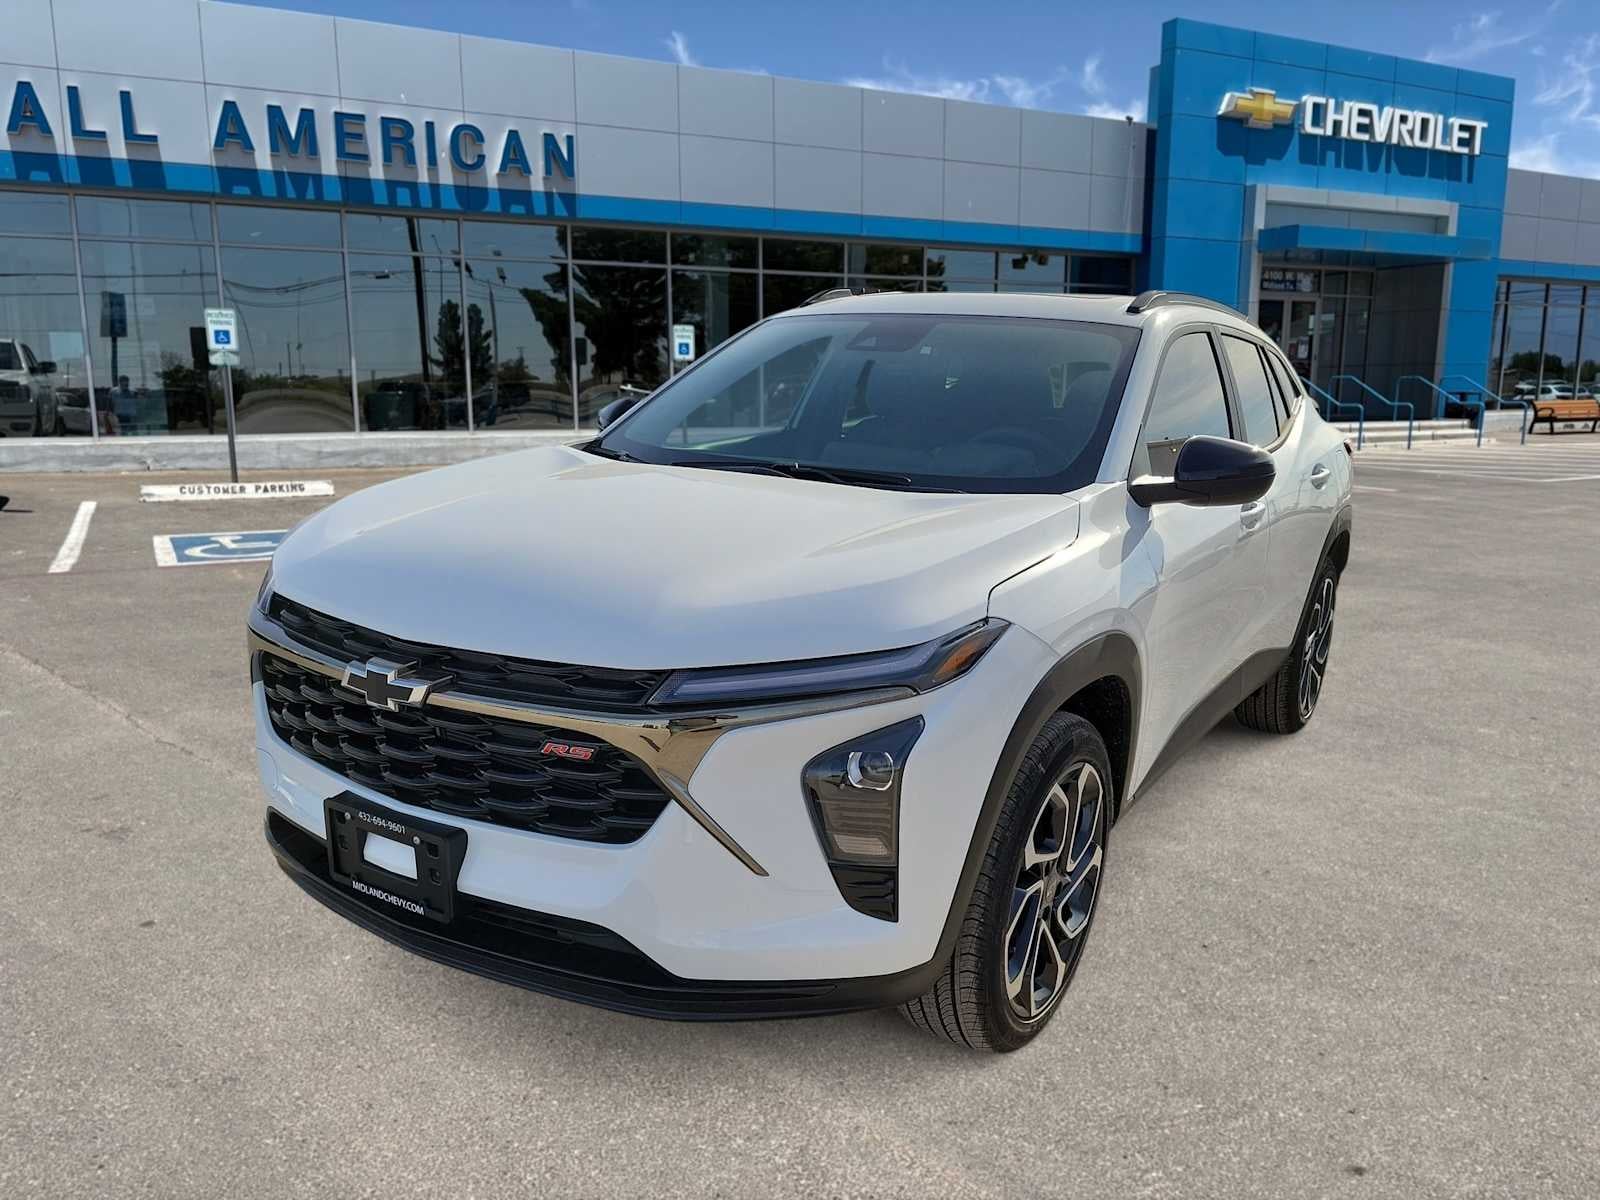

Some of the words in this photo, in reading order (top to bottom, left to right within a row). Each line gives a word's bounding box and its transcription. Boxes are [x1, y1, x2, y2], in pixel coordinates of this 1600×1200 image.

[7, 80, 158, 144] ALL
[213, 99, 576, 179] AMERICAN
[1302, 94, 1488, 155] CHEVROLET
[179, 485, 246, 495] CUSTOMER
[254, 483, 305, 494] PARKING
[541, 742, 594, 760] RS
[358, 811, 406, 834] 432-694-9601
[352, 881, 424, 915] MIDLANDCHEVY.COM
